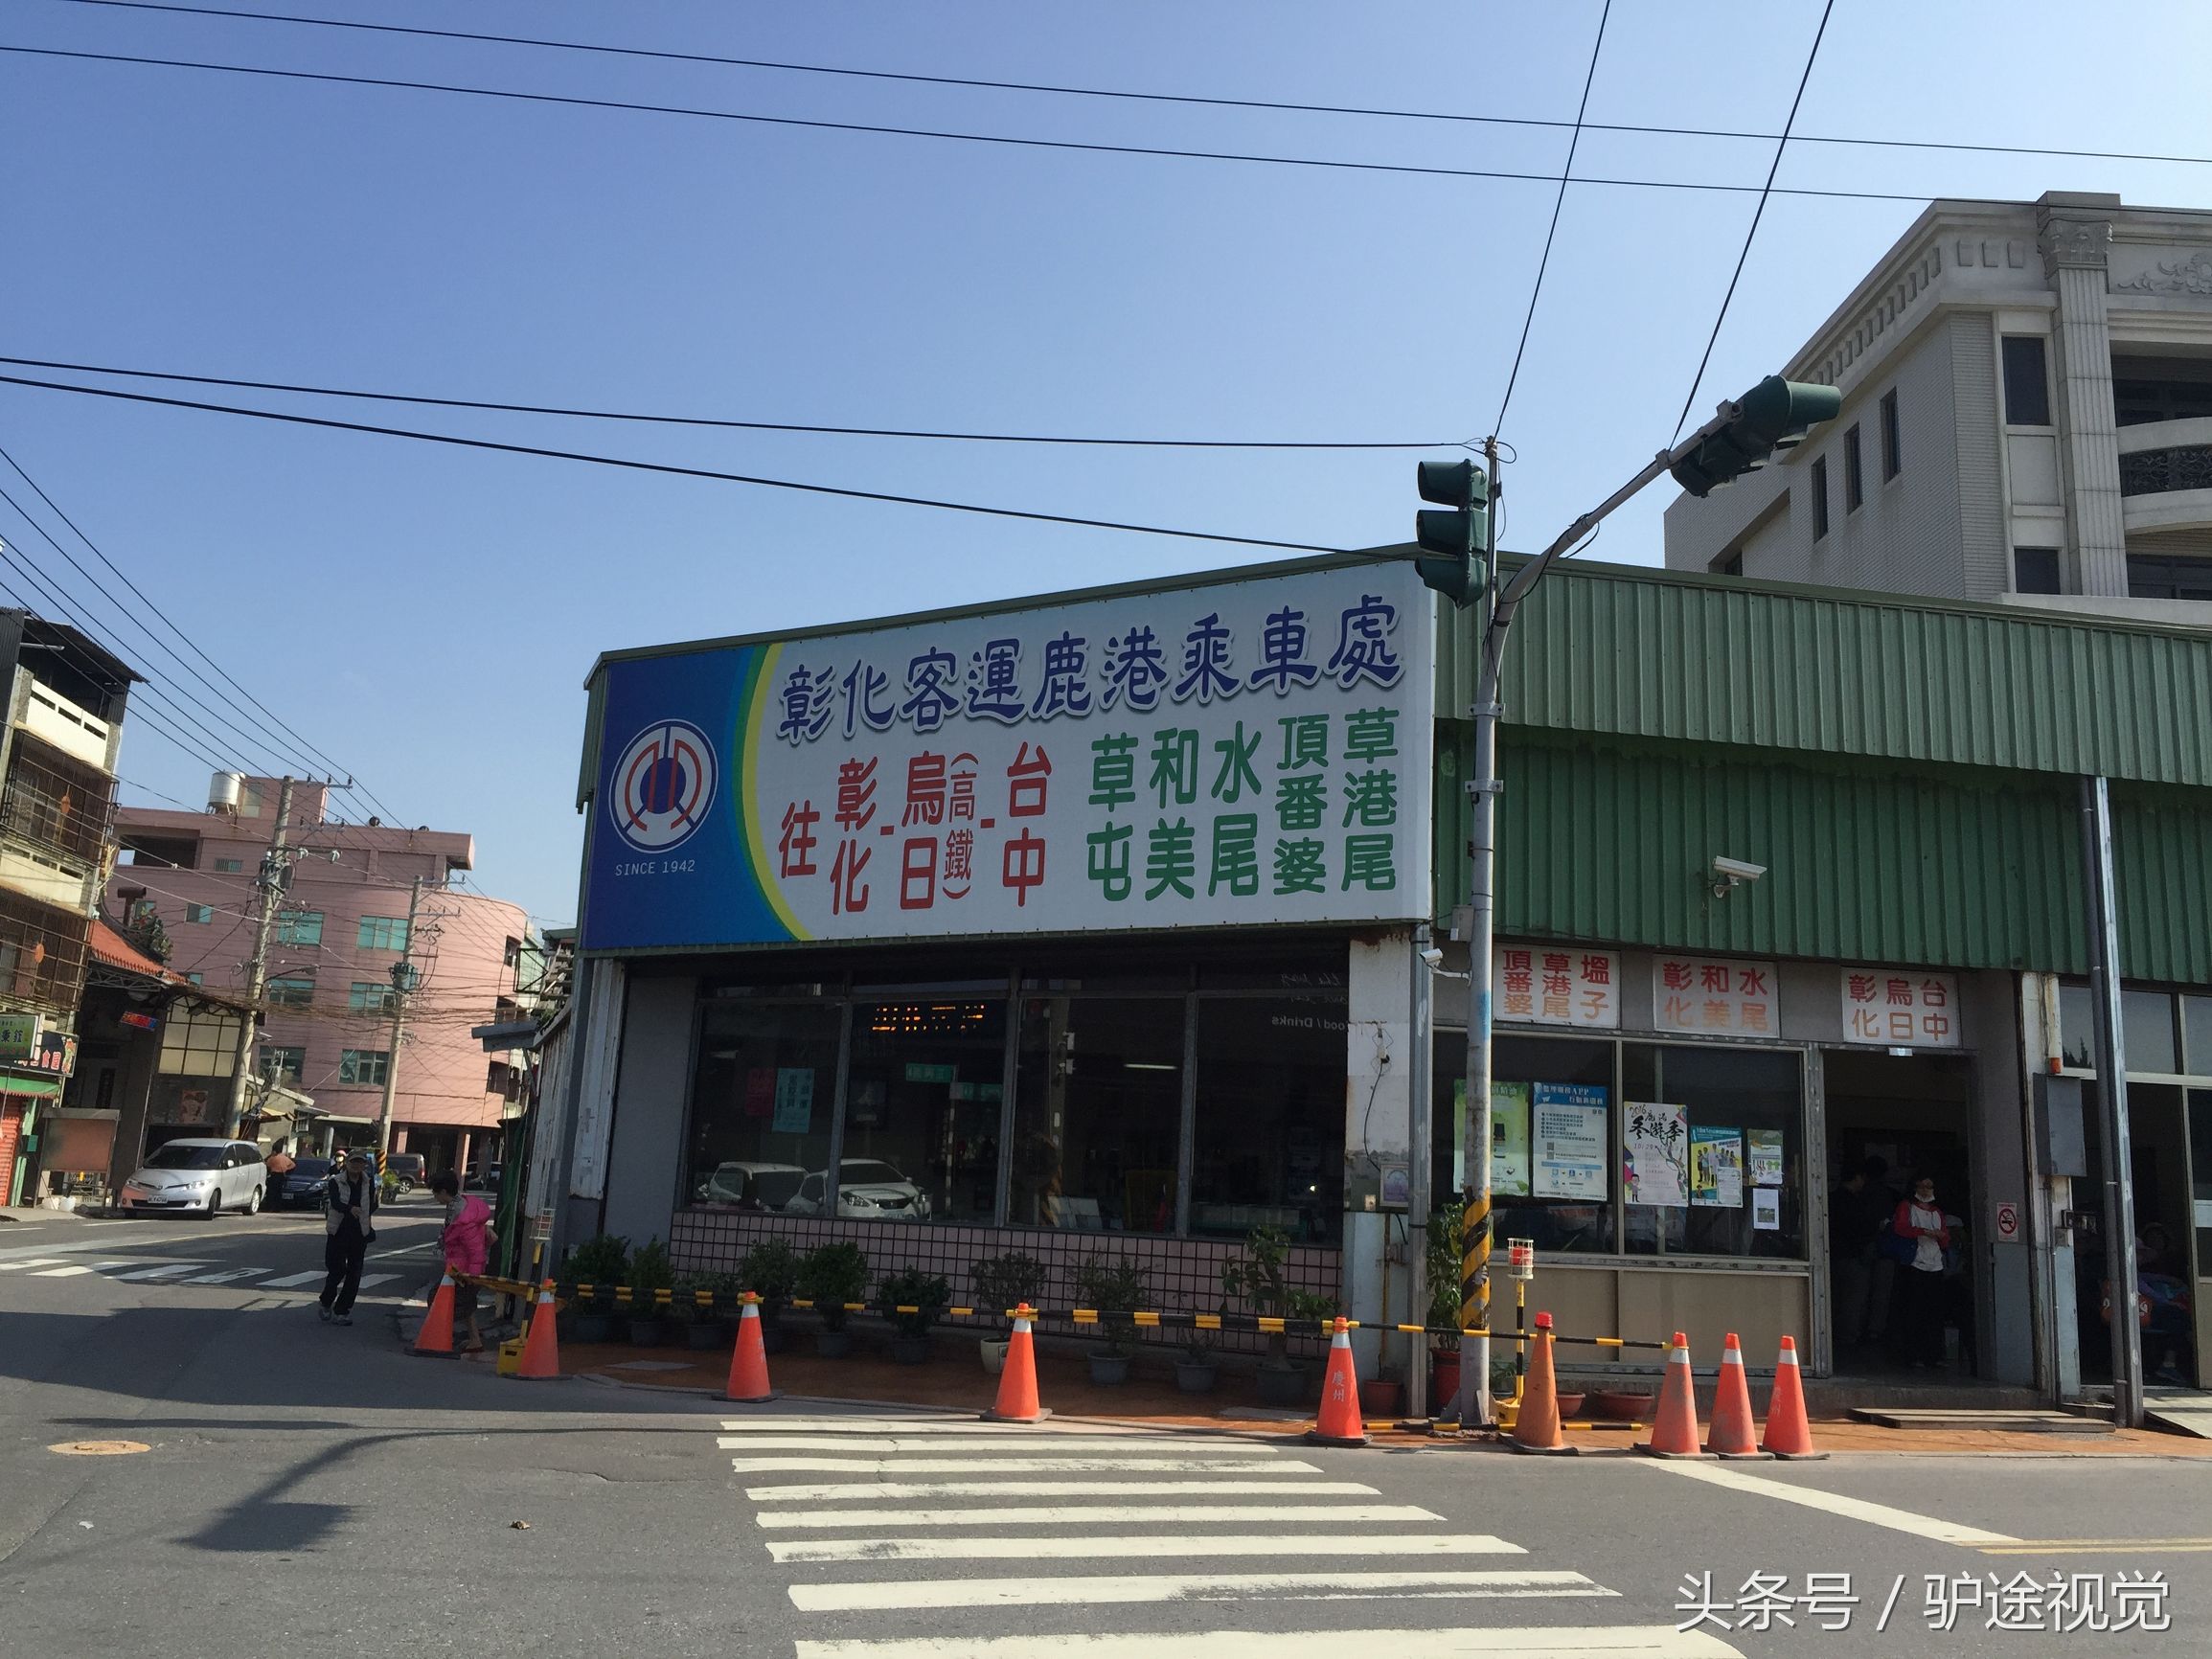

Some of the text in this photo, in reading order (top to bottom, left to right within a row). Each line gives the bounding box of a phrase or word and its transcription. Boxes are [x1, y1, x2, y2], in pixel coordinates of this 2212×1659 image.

[777, 594, 1403, 739] 彰化客運鹿港乘車處
[830, 756, 878, 915] 彰化
[901, 751, 946, 910] 烏日
[1002, 741, 1052, 907] 台中
[1086, 732, 1138, 901] 草屯
[1145, 727, 1199, 901] 和美
[1208, 720, 1262, 897] 水尾
[1273, 714, 1330, 895] 頂番婆
[1341, 707, 1400, 892] 草港尾
[615, 860, 696, 876] SINCE 1942
[779, 800, 820, 878] 往
[1502, 949, 1533, 1015] 頂番婆
[1540, 953, 1572, 1018] 草港尾
[1662, 962, 1693, 1027] 彰化
[1700, 965, 1731, 1027] 和美
[1739, 966, 1768, 1031] 水尾
[1848, 974, 1881, 1038] 彰化
[1886, 977, 1914, 1040] 烏日
[1920, 978, 1949, 1041] 台中
[1630, 1103, 1647, 1118] 2016
